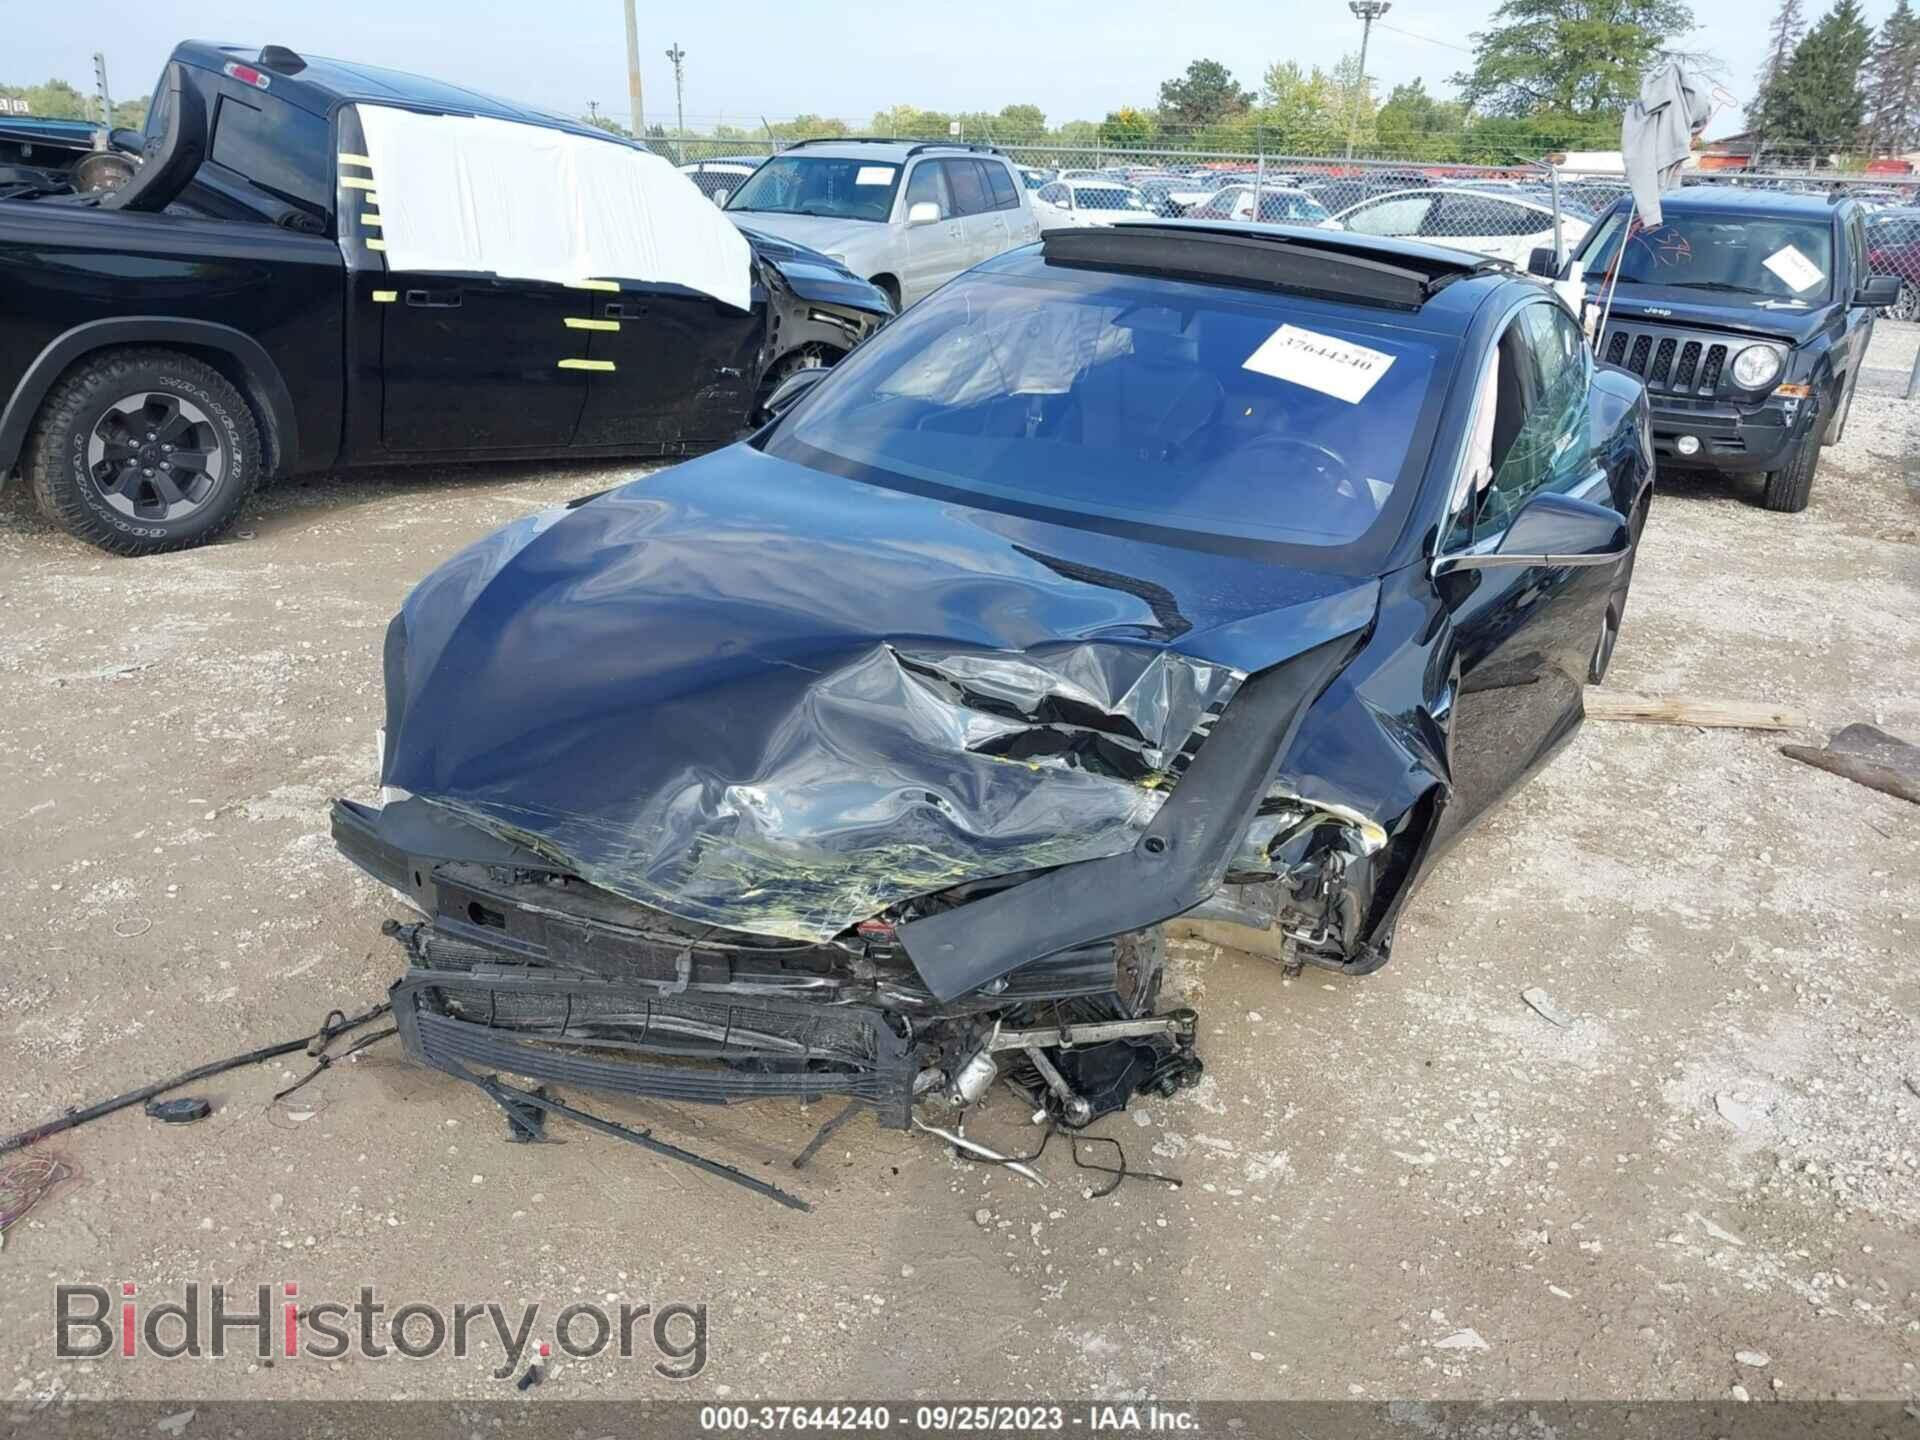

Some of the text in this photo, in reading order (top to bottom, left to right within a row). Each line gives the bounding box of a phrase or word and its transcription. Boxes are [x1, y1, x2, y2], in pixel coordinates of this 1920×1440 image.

[1643, 305, 1672, 318] Jeep
[1280, 337, 1372, 371] 37644240
[72, 433, 168, 538] GOODYEAR
